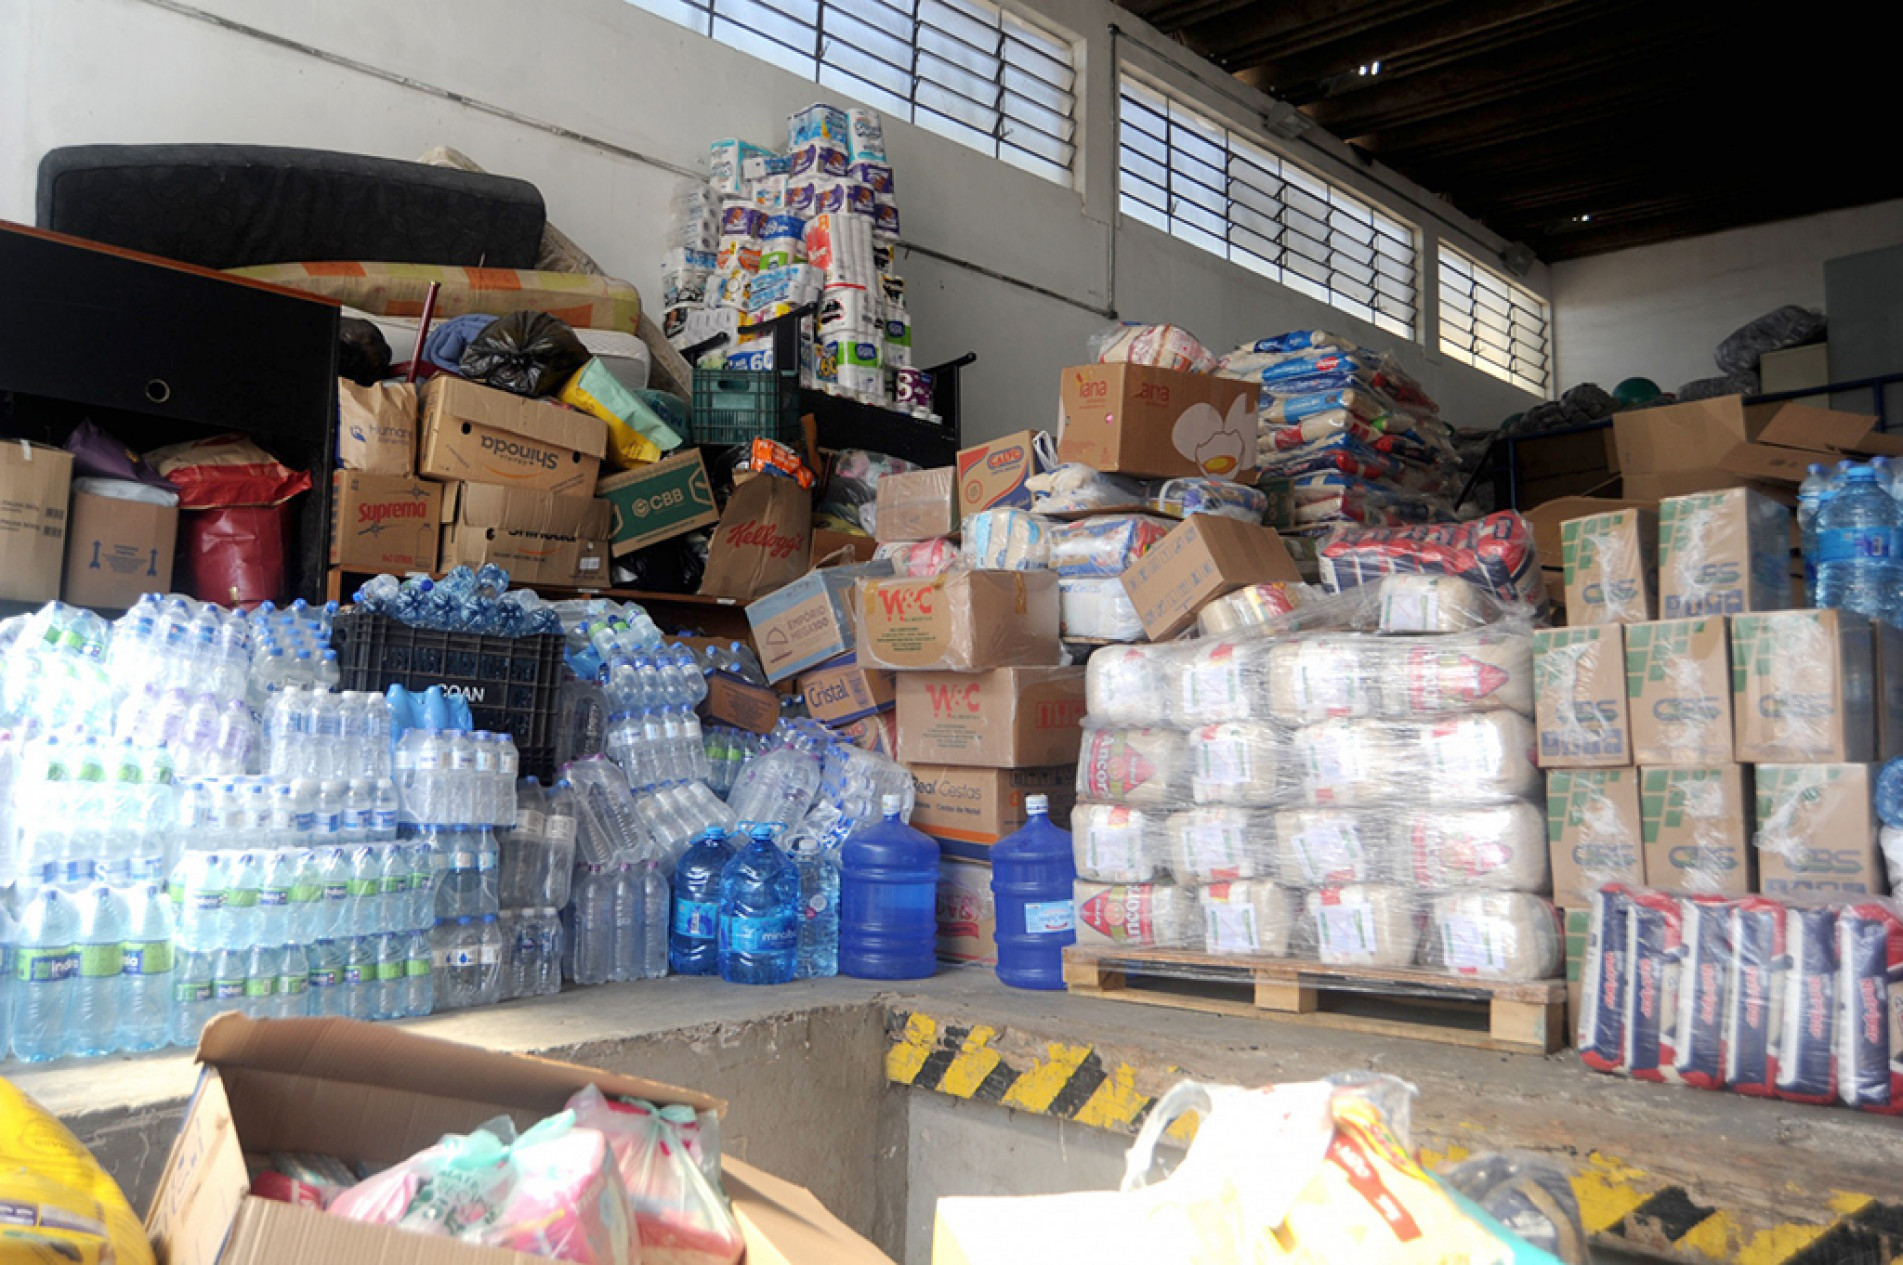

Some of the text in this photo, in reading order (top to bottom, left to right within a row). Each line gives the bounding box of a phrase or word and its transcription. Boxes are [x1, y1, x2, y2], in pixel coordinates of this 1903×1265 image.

[481, 434, 559, 471] Shinoda
[358, 500, 428, 524] Suprema
[726, 520, 803, 559] Kellogg's
[808, 679, 850, 708] Cristal
[938, 779, 982, 801] Cestas
